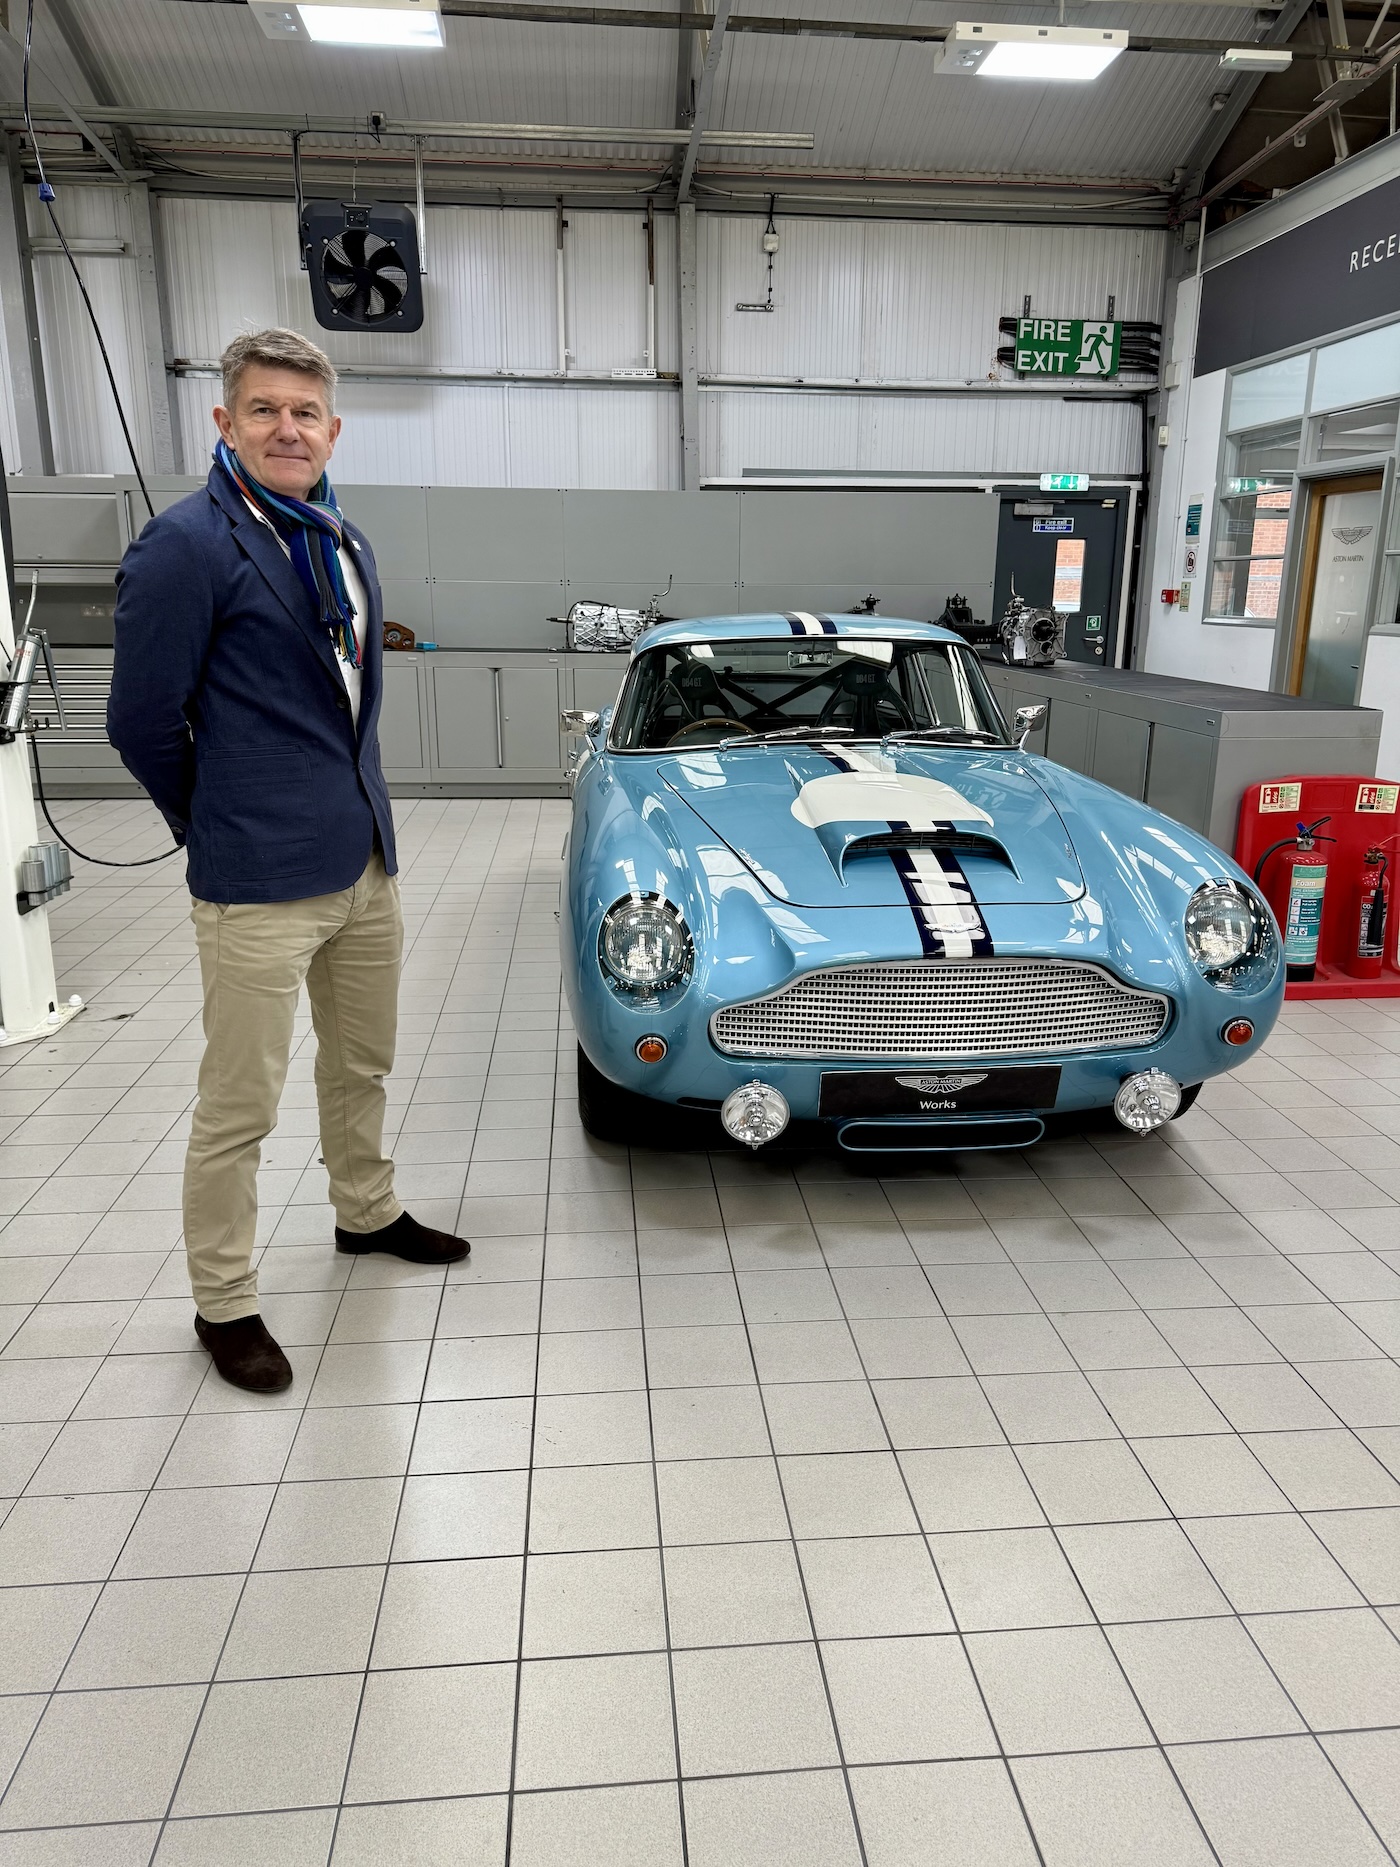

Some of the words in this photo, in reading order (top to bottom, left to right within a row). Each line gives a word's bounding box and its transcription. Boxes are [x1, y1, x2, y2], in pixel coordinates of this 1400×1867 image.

[1349, 233, 1400, 273] RECE
[1019, 319, 1072, 342] FIRE
[1017, 350, 1069, 372] EXIT
[919, 1100, 957, 1109] Works
